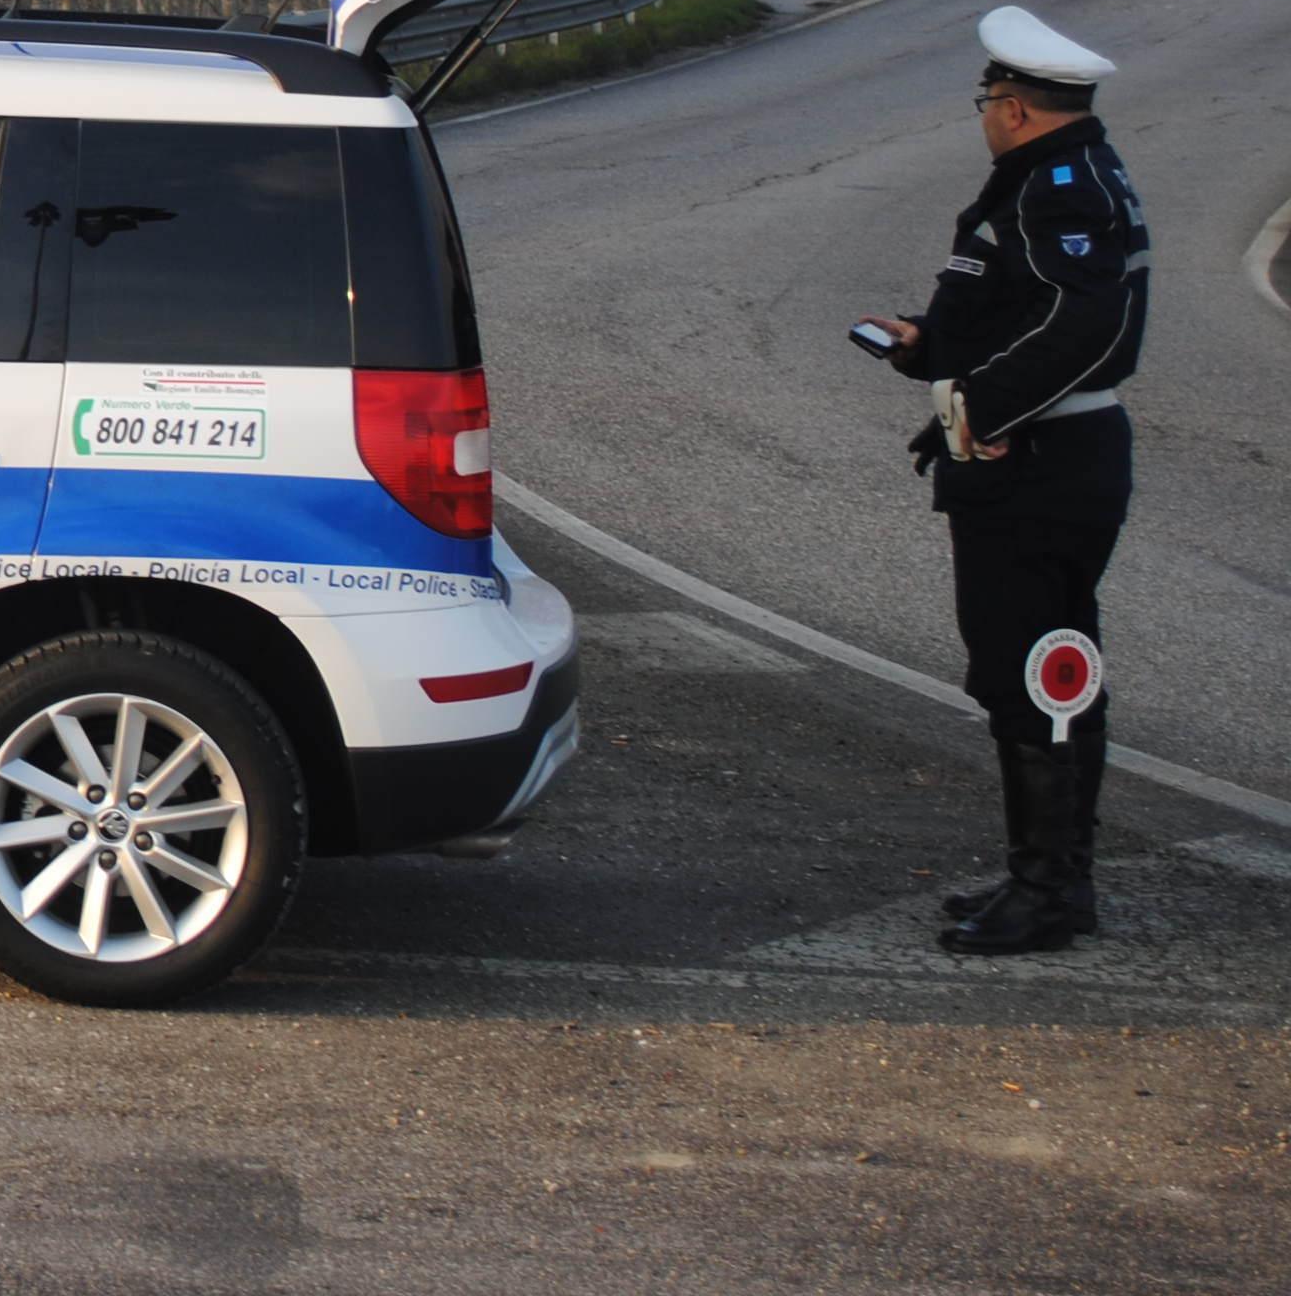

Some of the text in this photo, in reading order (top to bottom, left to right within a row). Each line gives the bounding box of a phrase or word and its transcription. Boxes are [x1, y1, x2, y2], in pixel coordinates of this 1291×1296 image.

[101, 399, 151, 410] Numero
[96, 416, 257, 447] 800 841 214
[41, 559, 123, 579] Locale
[148, 561, 230, 584] Policía
[240, 564, 305, 584] Local
[328, 568, 391, 591] Local
[398, 572, 458, 597] Police
